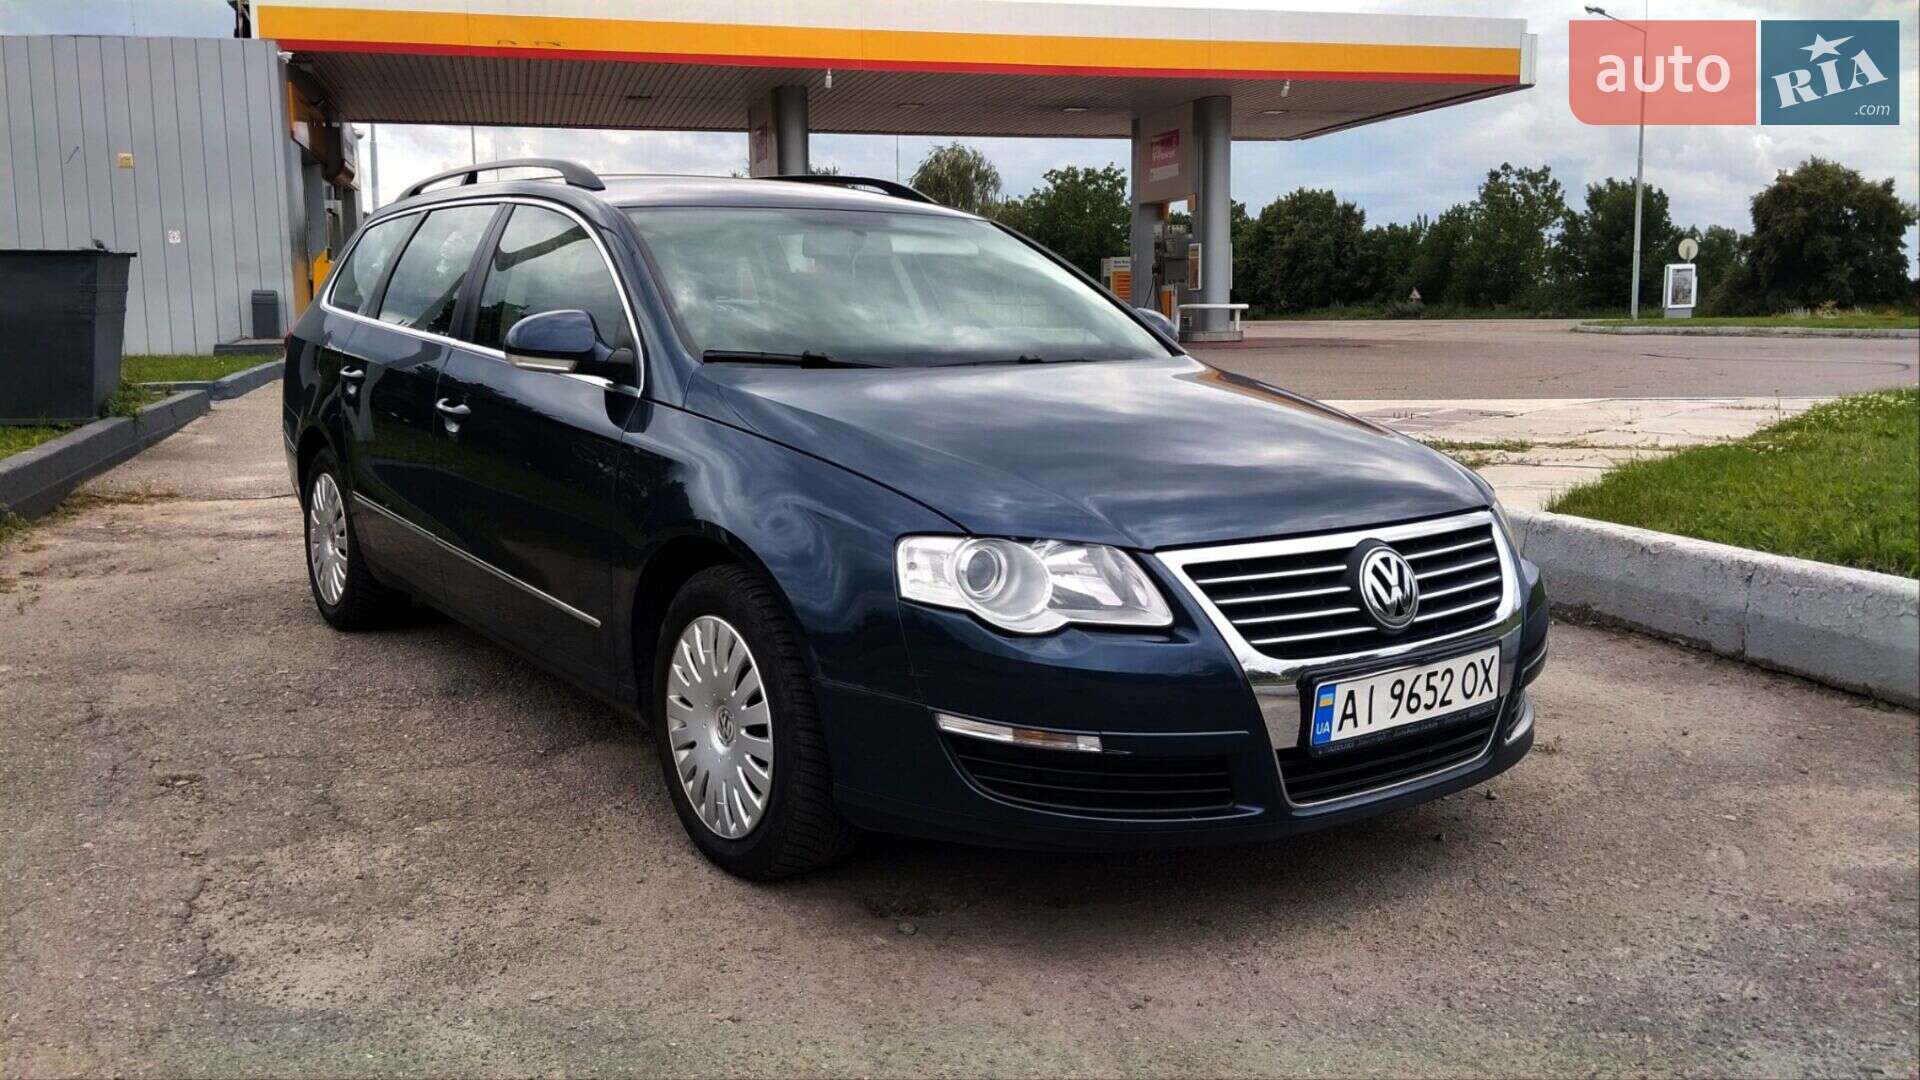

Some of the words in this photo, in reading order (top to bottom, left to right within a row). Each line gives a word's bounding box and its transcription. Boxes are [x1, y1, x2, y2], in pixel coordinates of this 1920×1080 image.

[1337, 685, 1374, 732] AI
[1390, 667, 1454, 720] 9652
[1462, 655, 1496, 700] OX
[1316, 721, 1330, 735] UA
